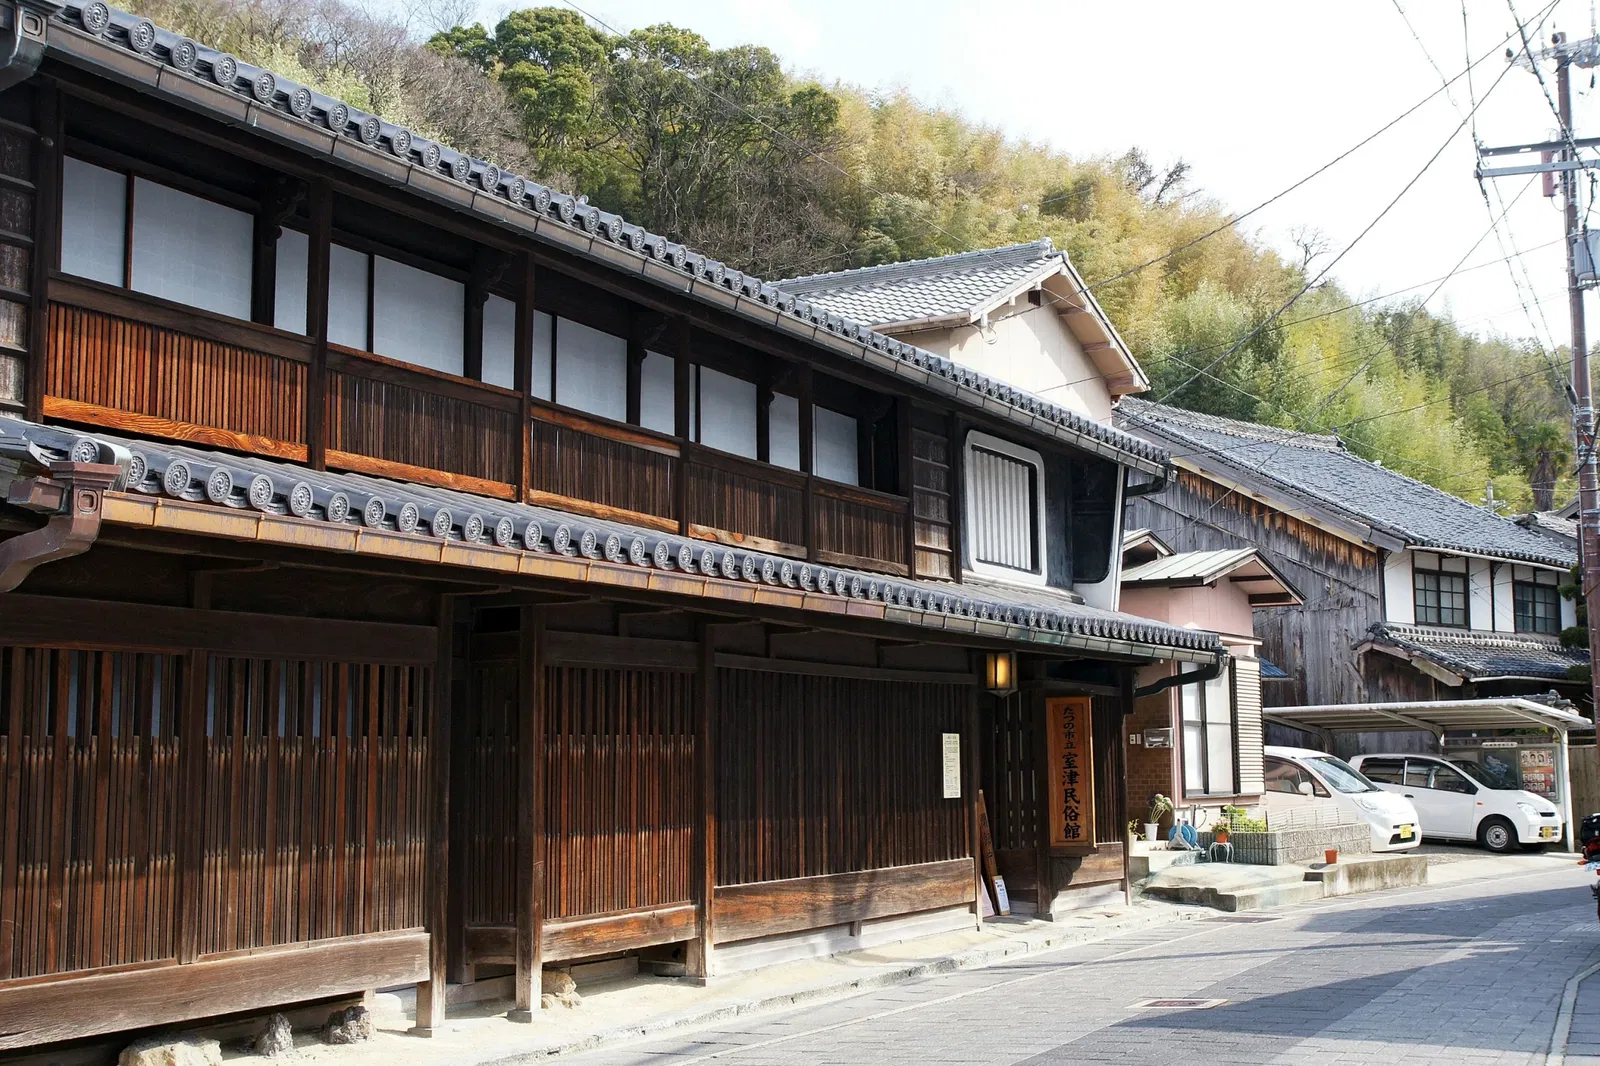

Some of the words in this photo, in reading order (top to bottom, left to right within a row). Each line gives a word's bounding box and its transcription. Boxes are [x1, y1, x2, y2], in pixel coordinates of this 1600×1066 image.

[1062, 706, 1081, 840] たつの市立室津民俗館
